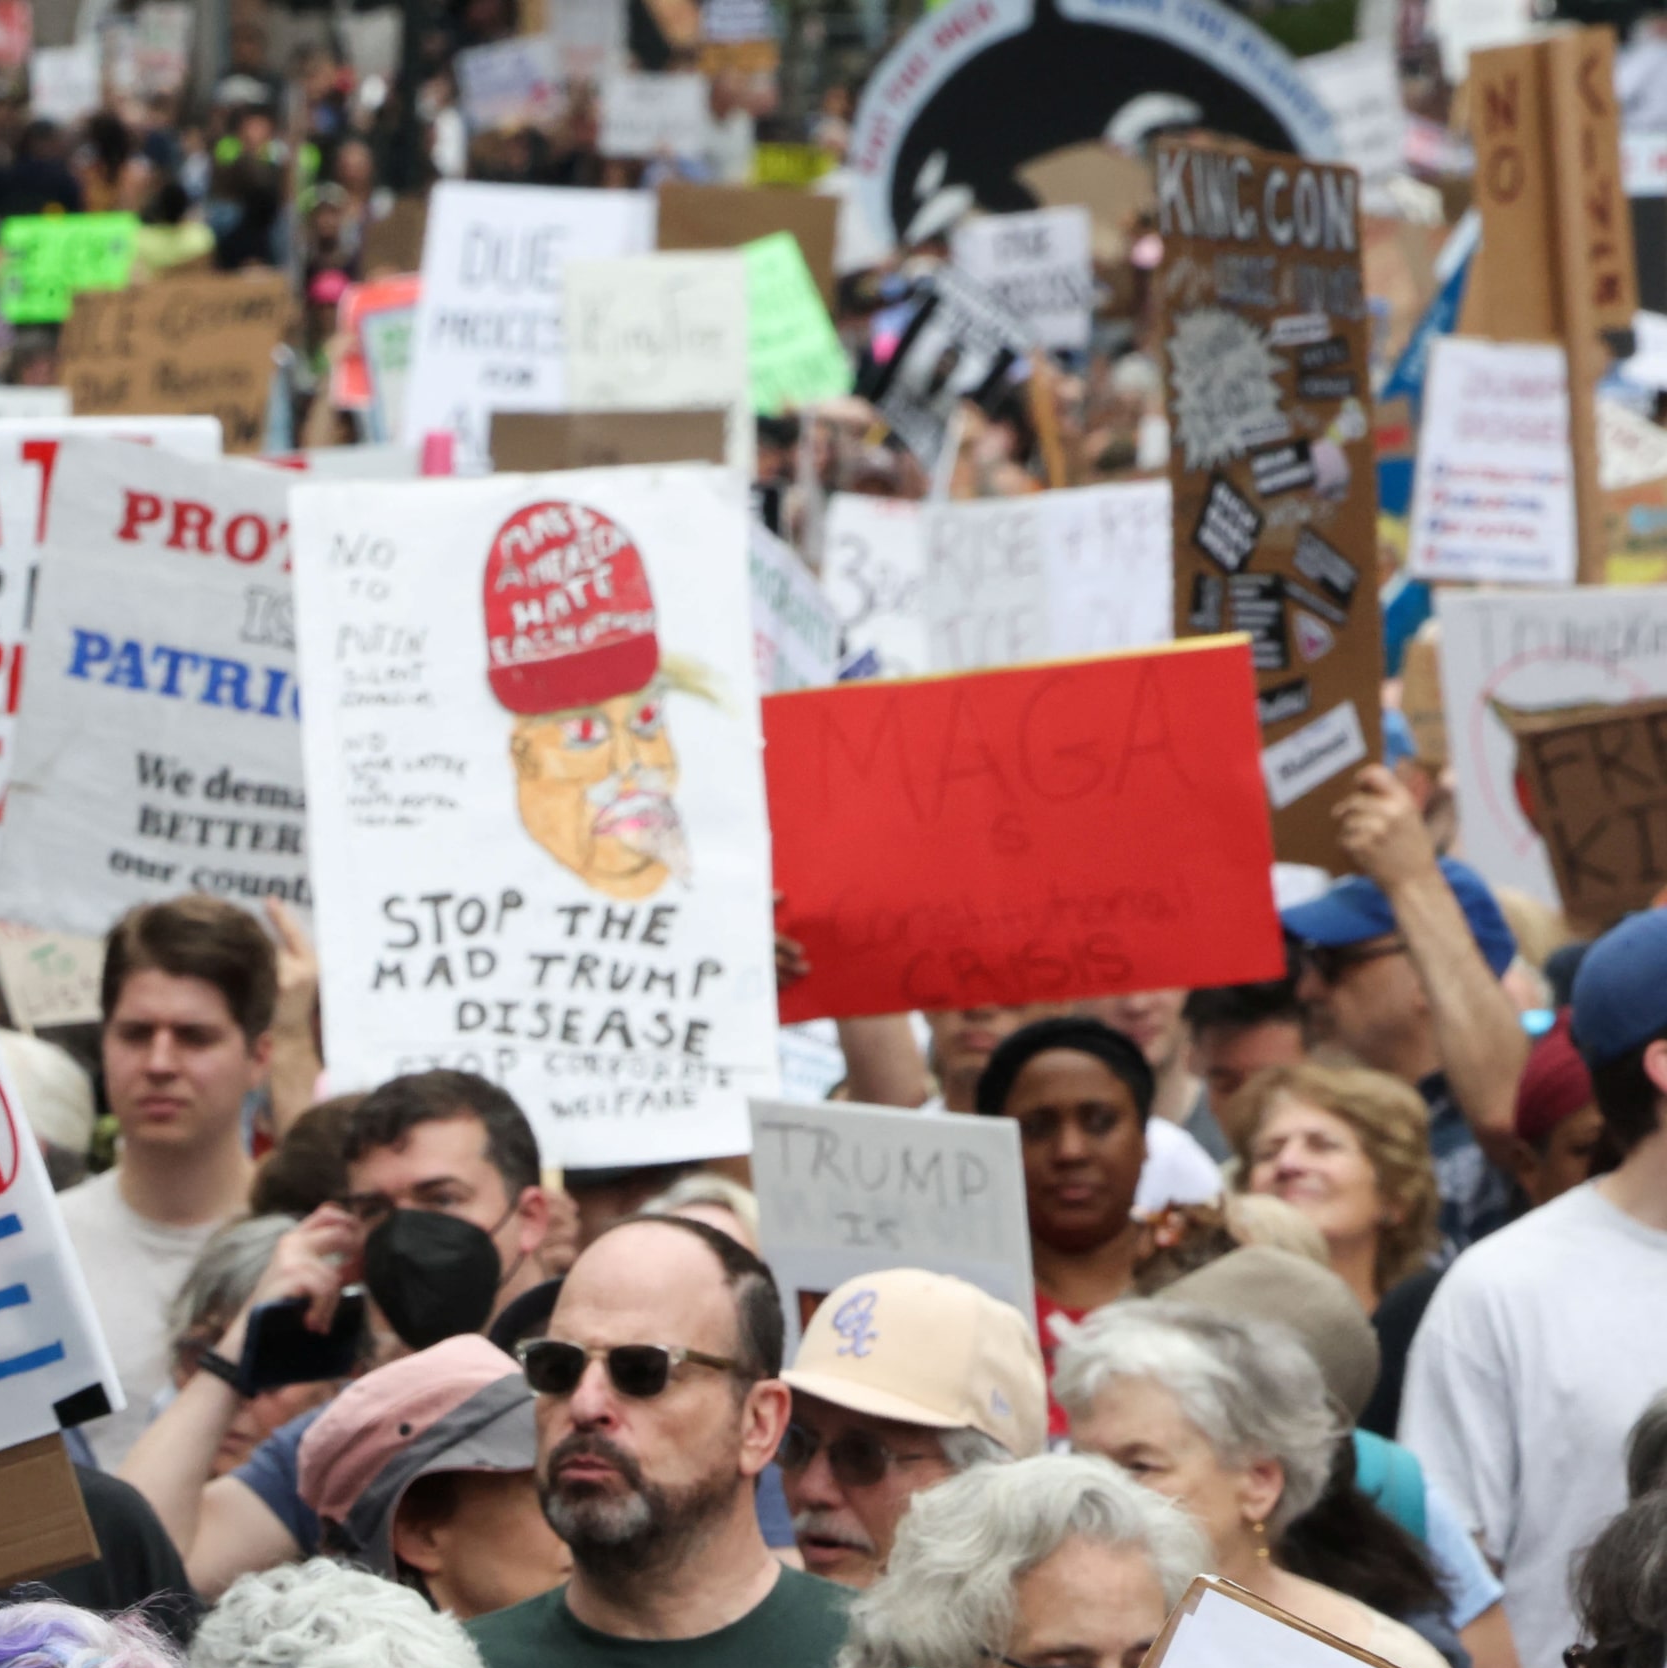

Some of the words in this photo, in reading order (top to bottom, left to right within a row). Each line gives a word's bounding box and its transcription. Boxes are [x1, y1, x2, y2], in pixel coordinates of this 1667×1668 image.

[1157, 148, 1259, 240] KING
[1264, 164, 1358, 252] CON
[817, 660, 1199, 826] MAGA
[136, 751, 194, 798] We
[137, 805, 304, 858] BETTER
[108, 849, 176, 885] our
[382, 889, 525, 950] STOP
[557, 904, 679, 946] THE
[371, 949, 497, 992] MAD
[527, 953, 728, 1000] TRUMP
[902, 932, 1133, 1008] CRISIS
[456, 1000, 711, 1058] DISEASE
[761, 1120, 990, 1208] TRUMP
[835, 1209, 901, 1251] IS
